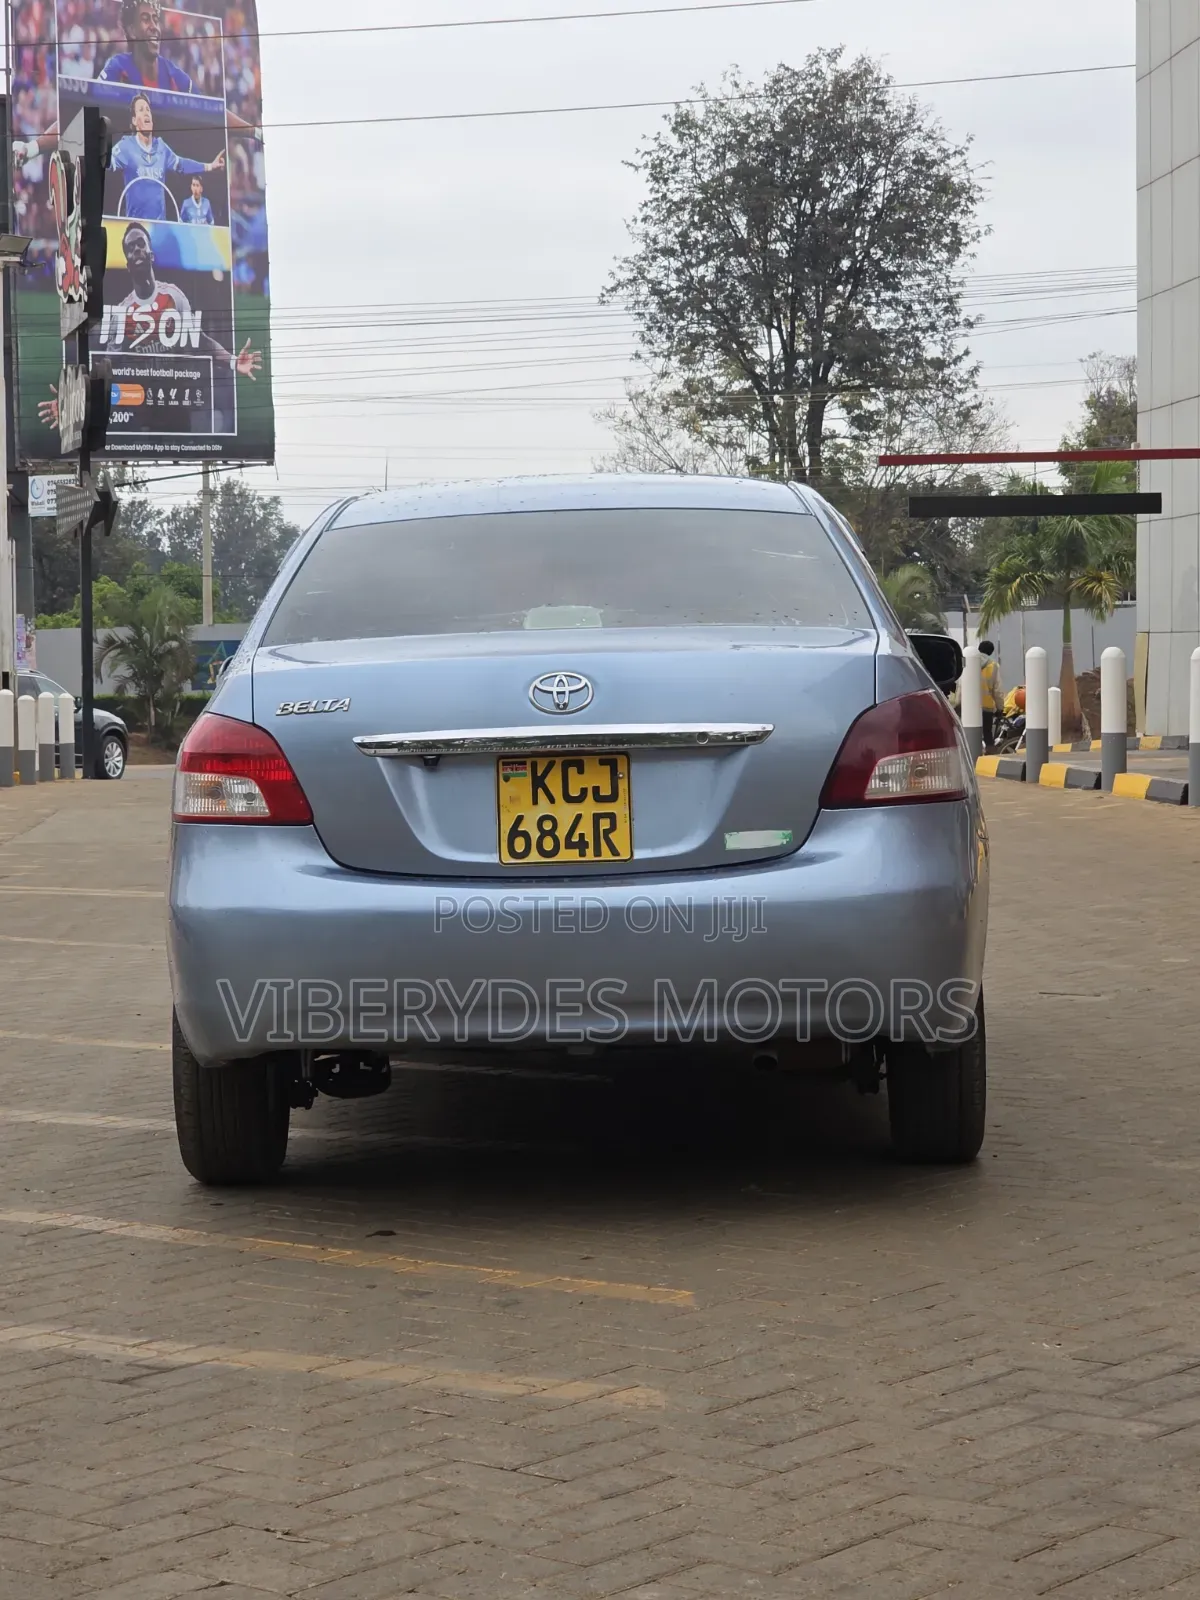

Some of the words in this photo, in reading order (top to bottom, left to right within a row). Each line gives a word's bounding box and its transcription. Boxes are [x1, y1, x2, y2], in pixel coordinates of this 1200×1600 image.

[158, 308, 203, 348] ON
[112, 367, 135, 376] world's
[135, 367, 149, 377] best
[150, 368, 174, 377] football
[174, 369, 201, 380] package
[108, 411, 130, 424] ,200
[111, 443, 136, 451] Download
[154, 444, 164, 452] App
[170, 444, 180, 452] stay
[275, 697, 352, 716] BELTA
[531, 758, 620, 805] KCJ
[507, 811, 621, 860] 684R
